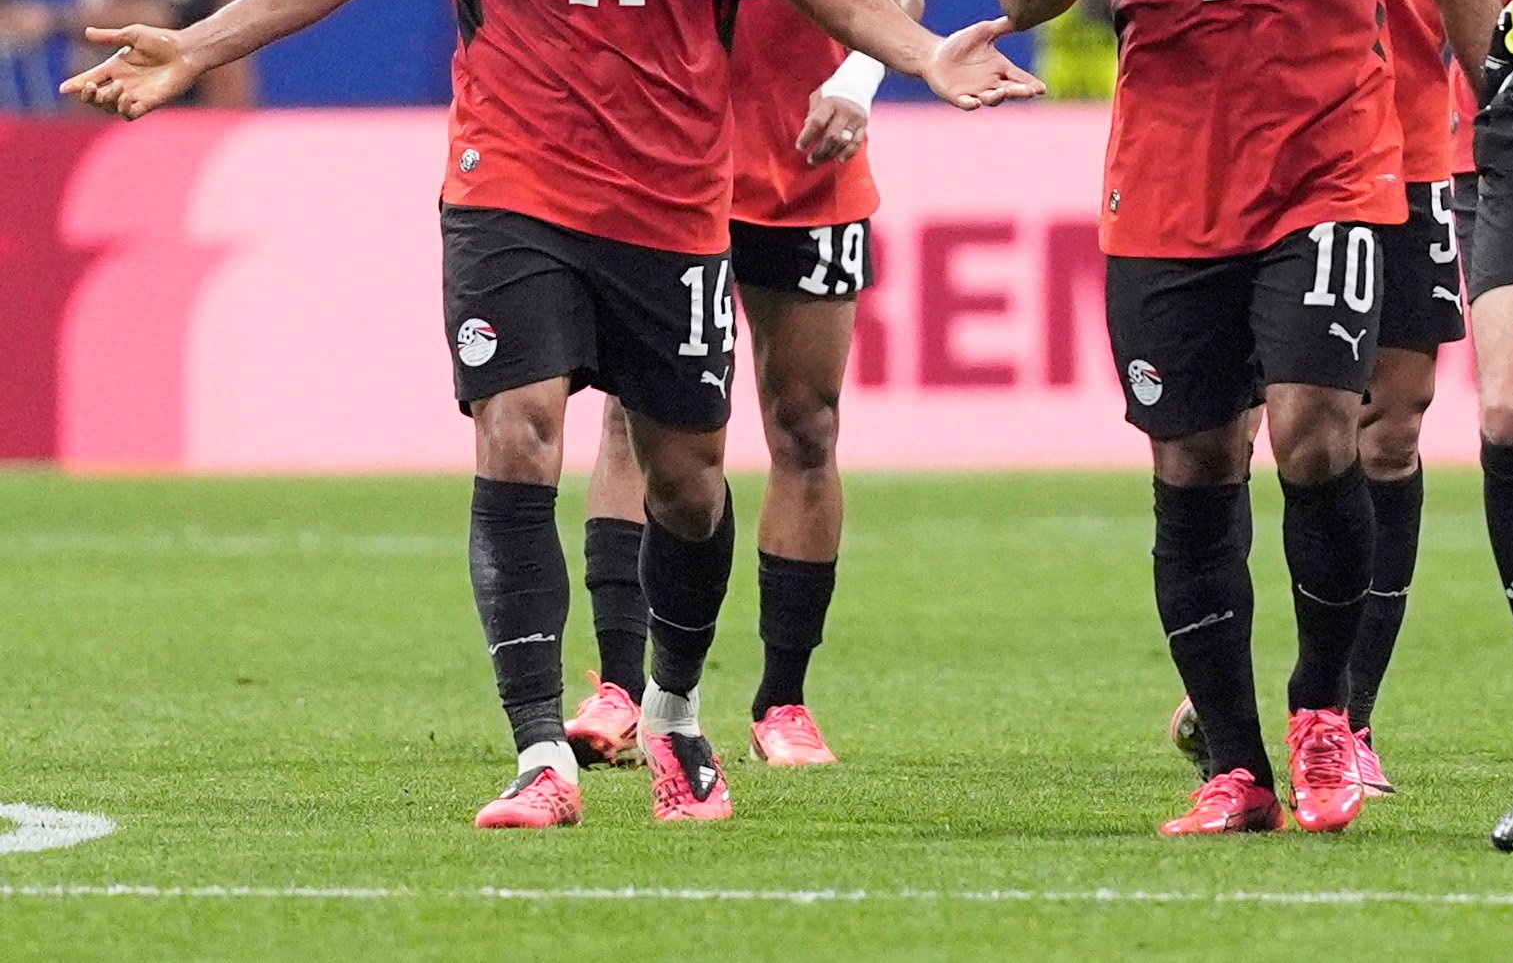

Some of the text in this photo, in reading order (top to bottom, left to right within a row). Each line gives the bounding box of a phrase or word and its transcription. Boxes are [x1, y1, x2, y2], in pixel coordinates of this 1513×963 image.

[799, 223, 865, 295] 19
[1429, 180, 1458, 264] 5
[678, 259, 735, 356] 14
[1303, 221, 1376, 314] 10
